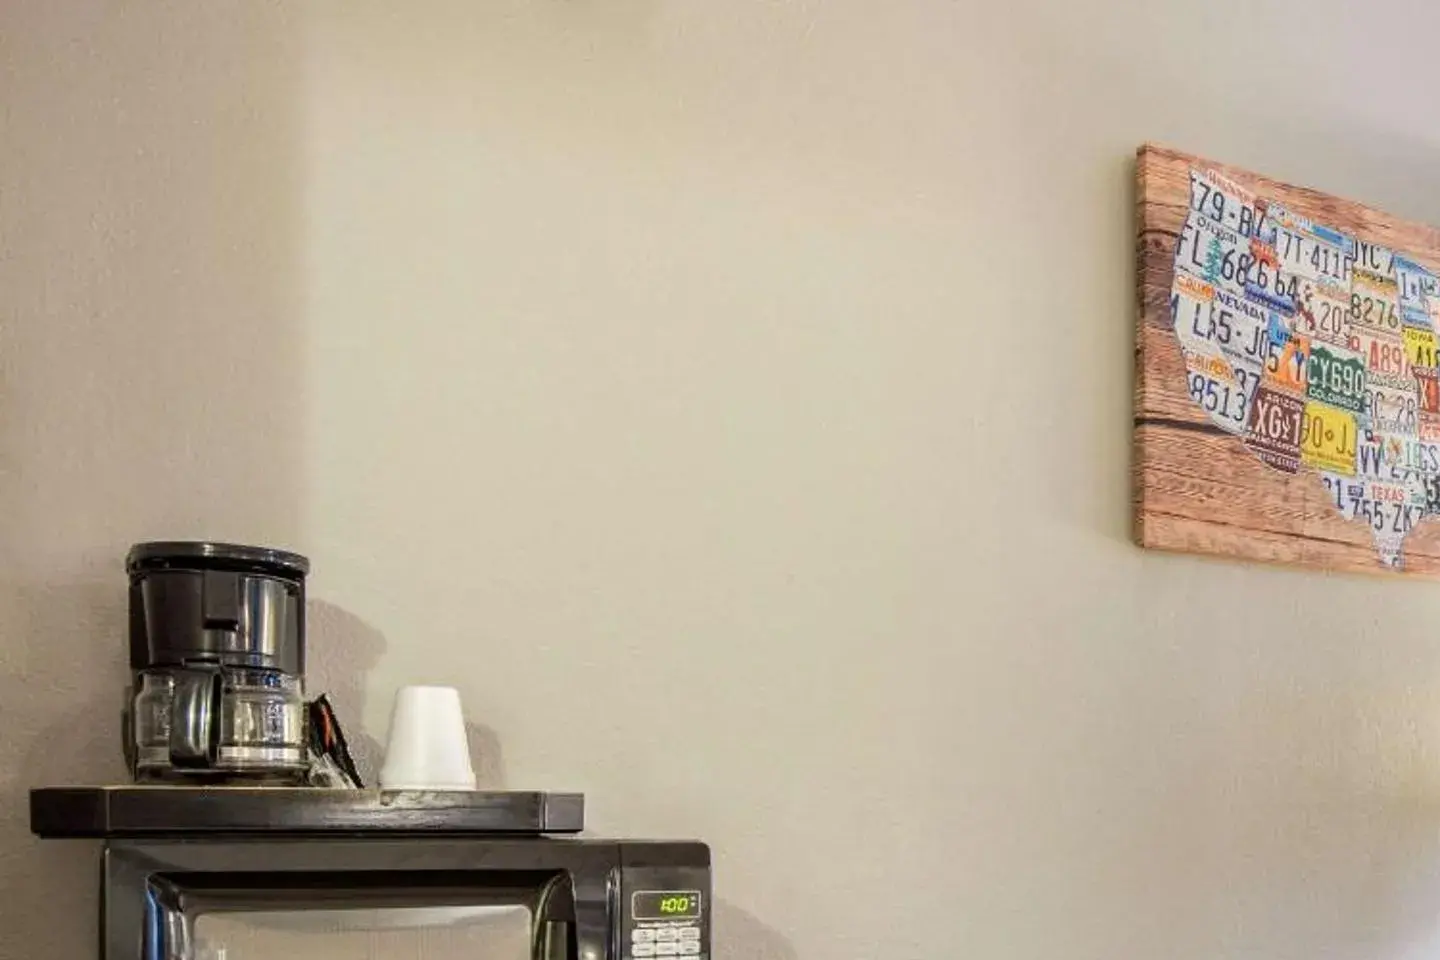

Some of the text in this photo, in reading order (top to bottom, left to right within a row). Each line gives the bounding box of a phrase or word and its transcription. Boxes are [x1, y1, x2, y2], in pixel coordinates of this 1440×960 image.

[1217, 290, 1266, 323] NEVADA
[1307, 355, 1364, 398] CY690
[1371, 483, 1405, 501] TEXAS
